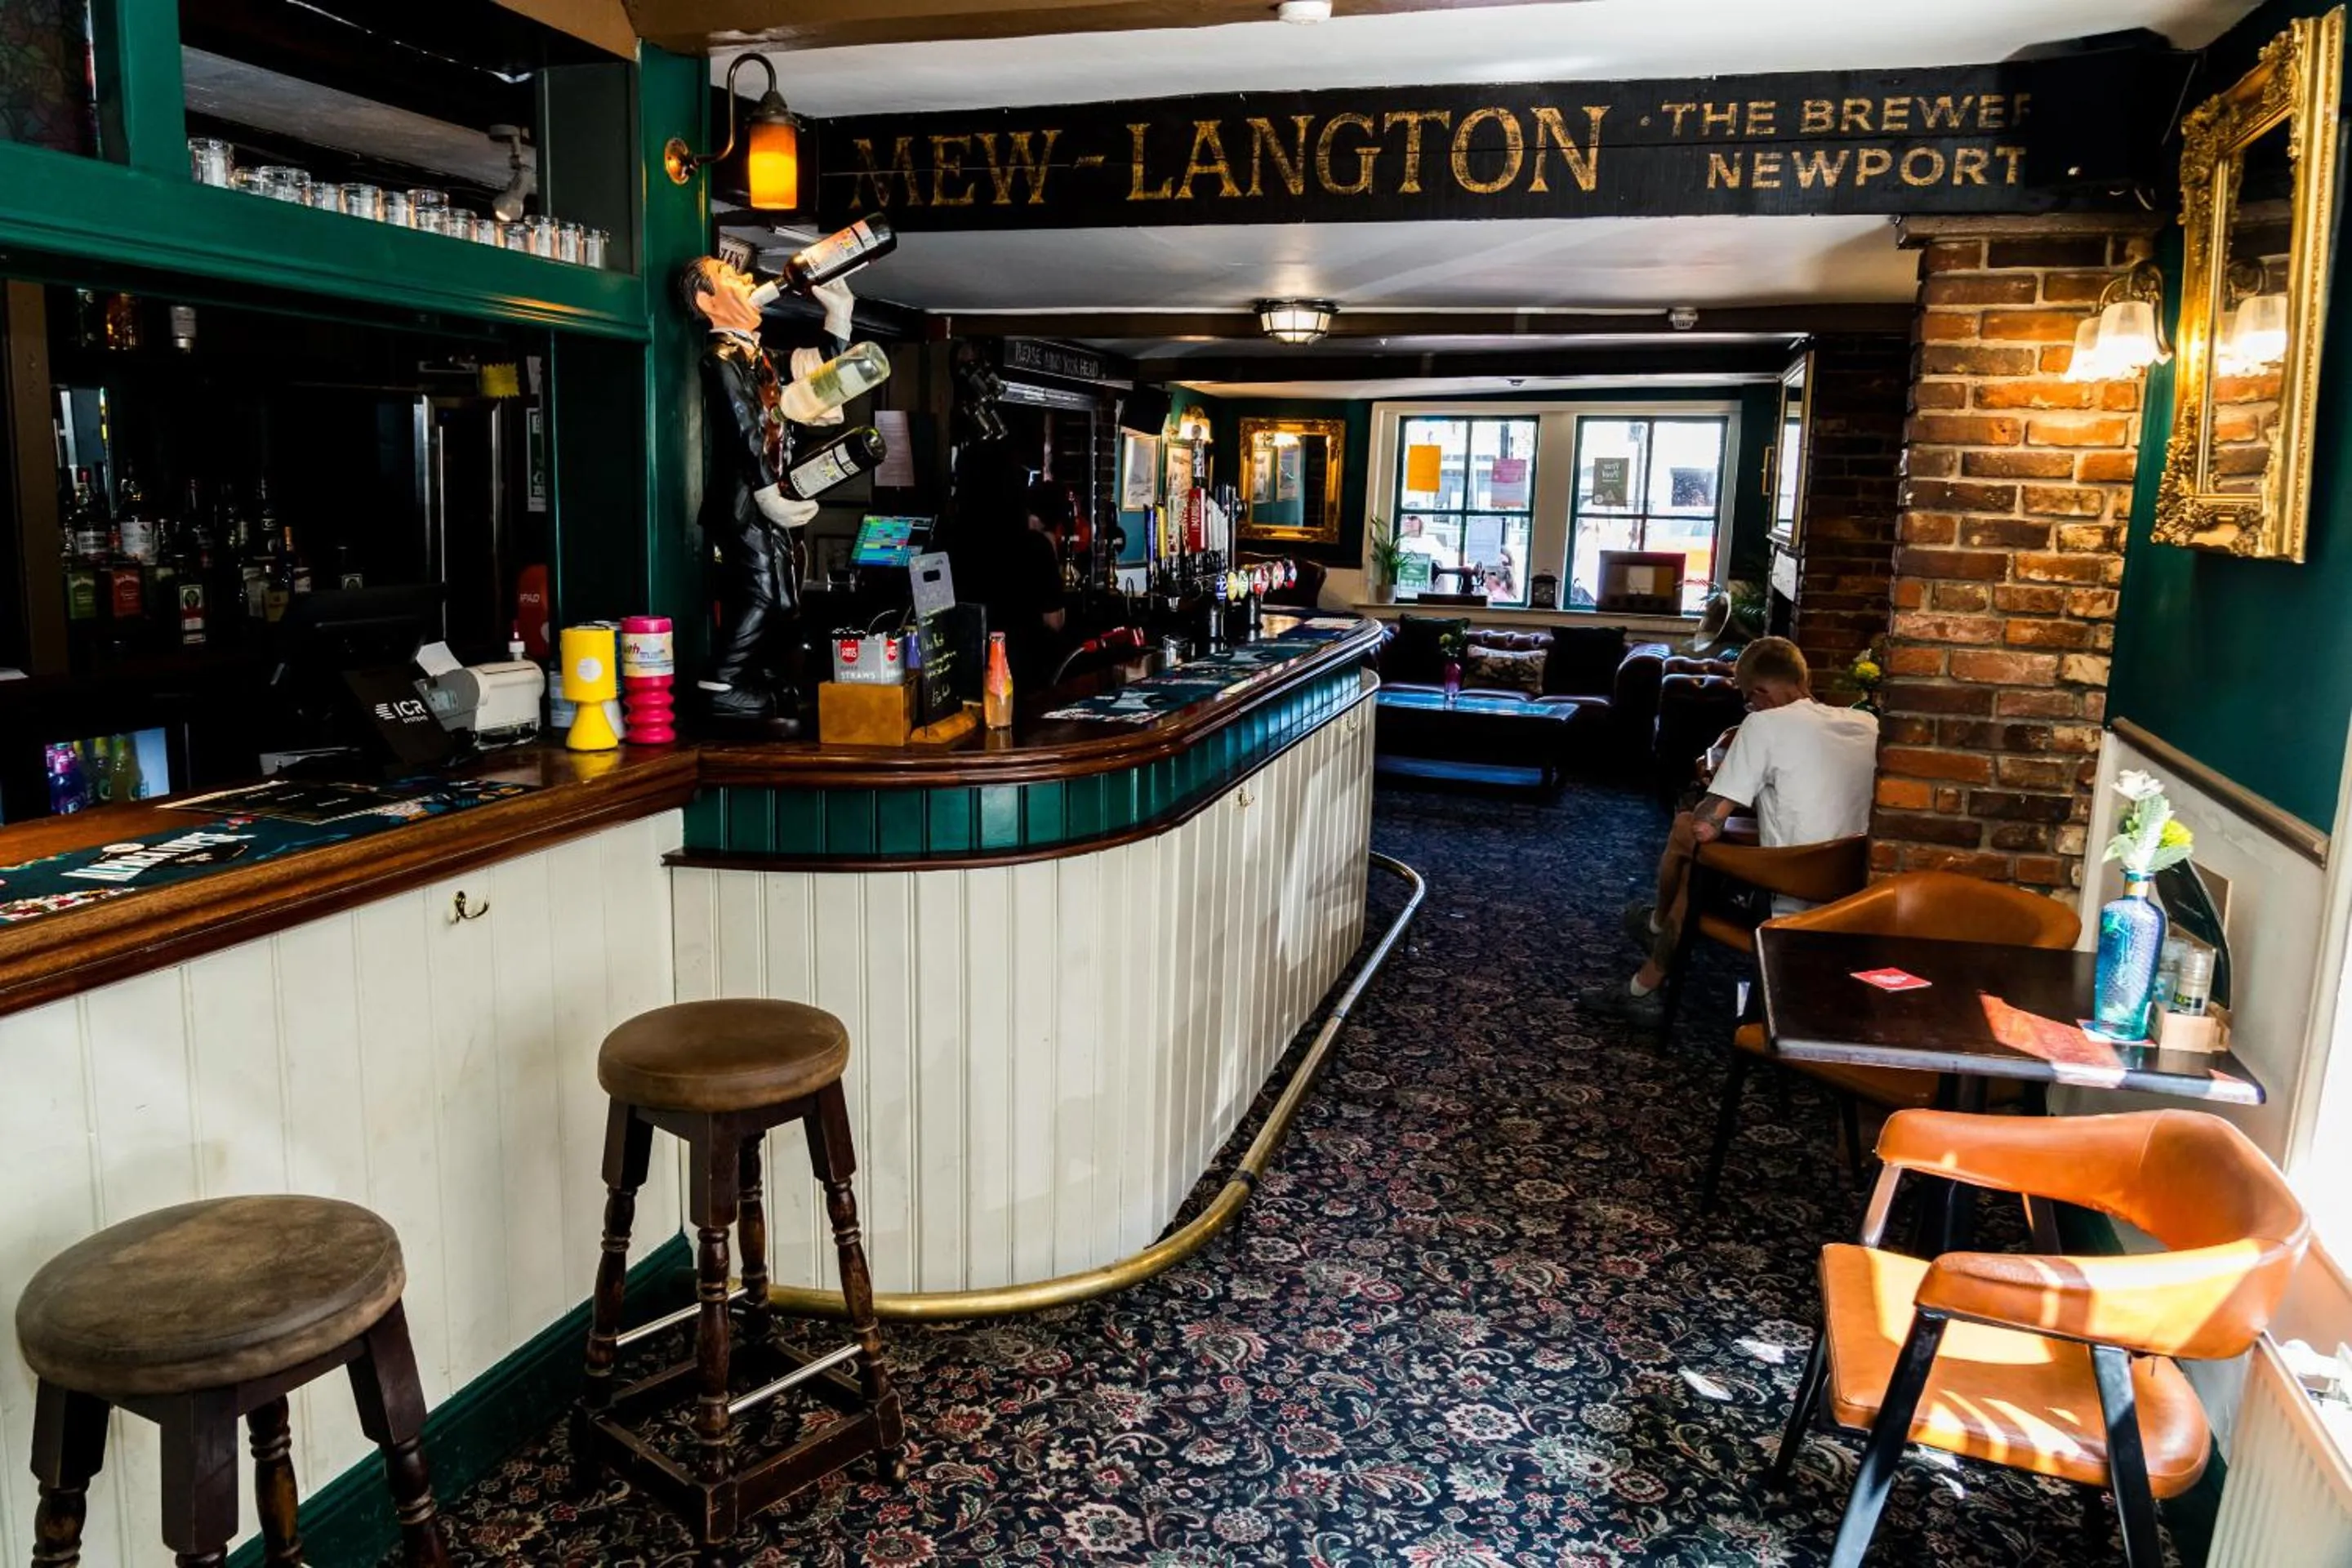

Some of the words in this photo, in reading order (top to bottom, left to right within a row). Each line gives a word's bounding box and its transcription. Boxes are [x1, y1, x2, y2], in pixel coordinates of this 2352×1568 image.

[1660, 100, 1776, 137] THE
[852, 128, 1062, 210] MEW
[1125, 104, 1612, 203] LANGTON
[1705, 145, 2028, 191] NEWPORT
[840, 670, 876, 680] STRAWS
[392, 699, 427, 718] ICR
